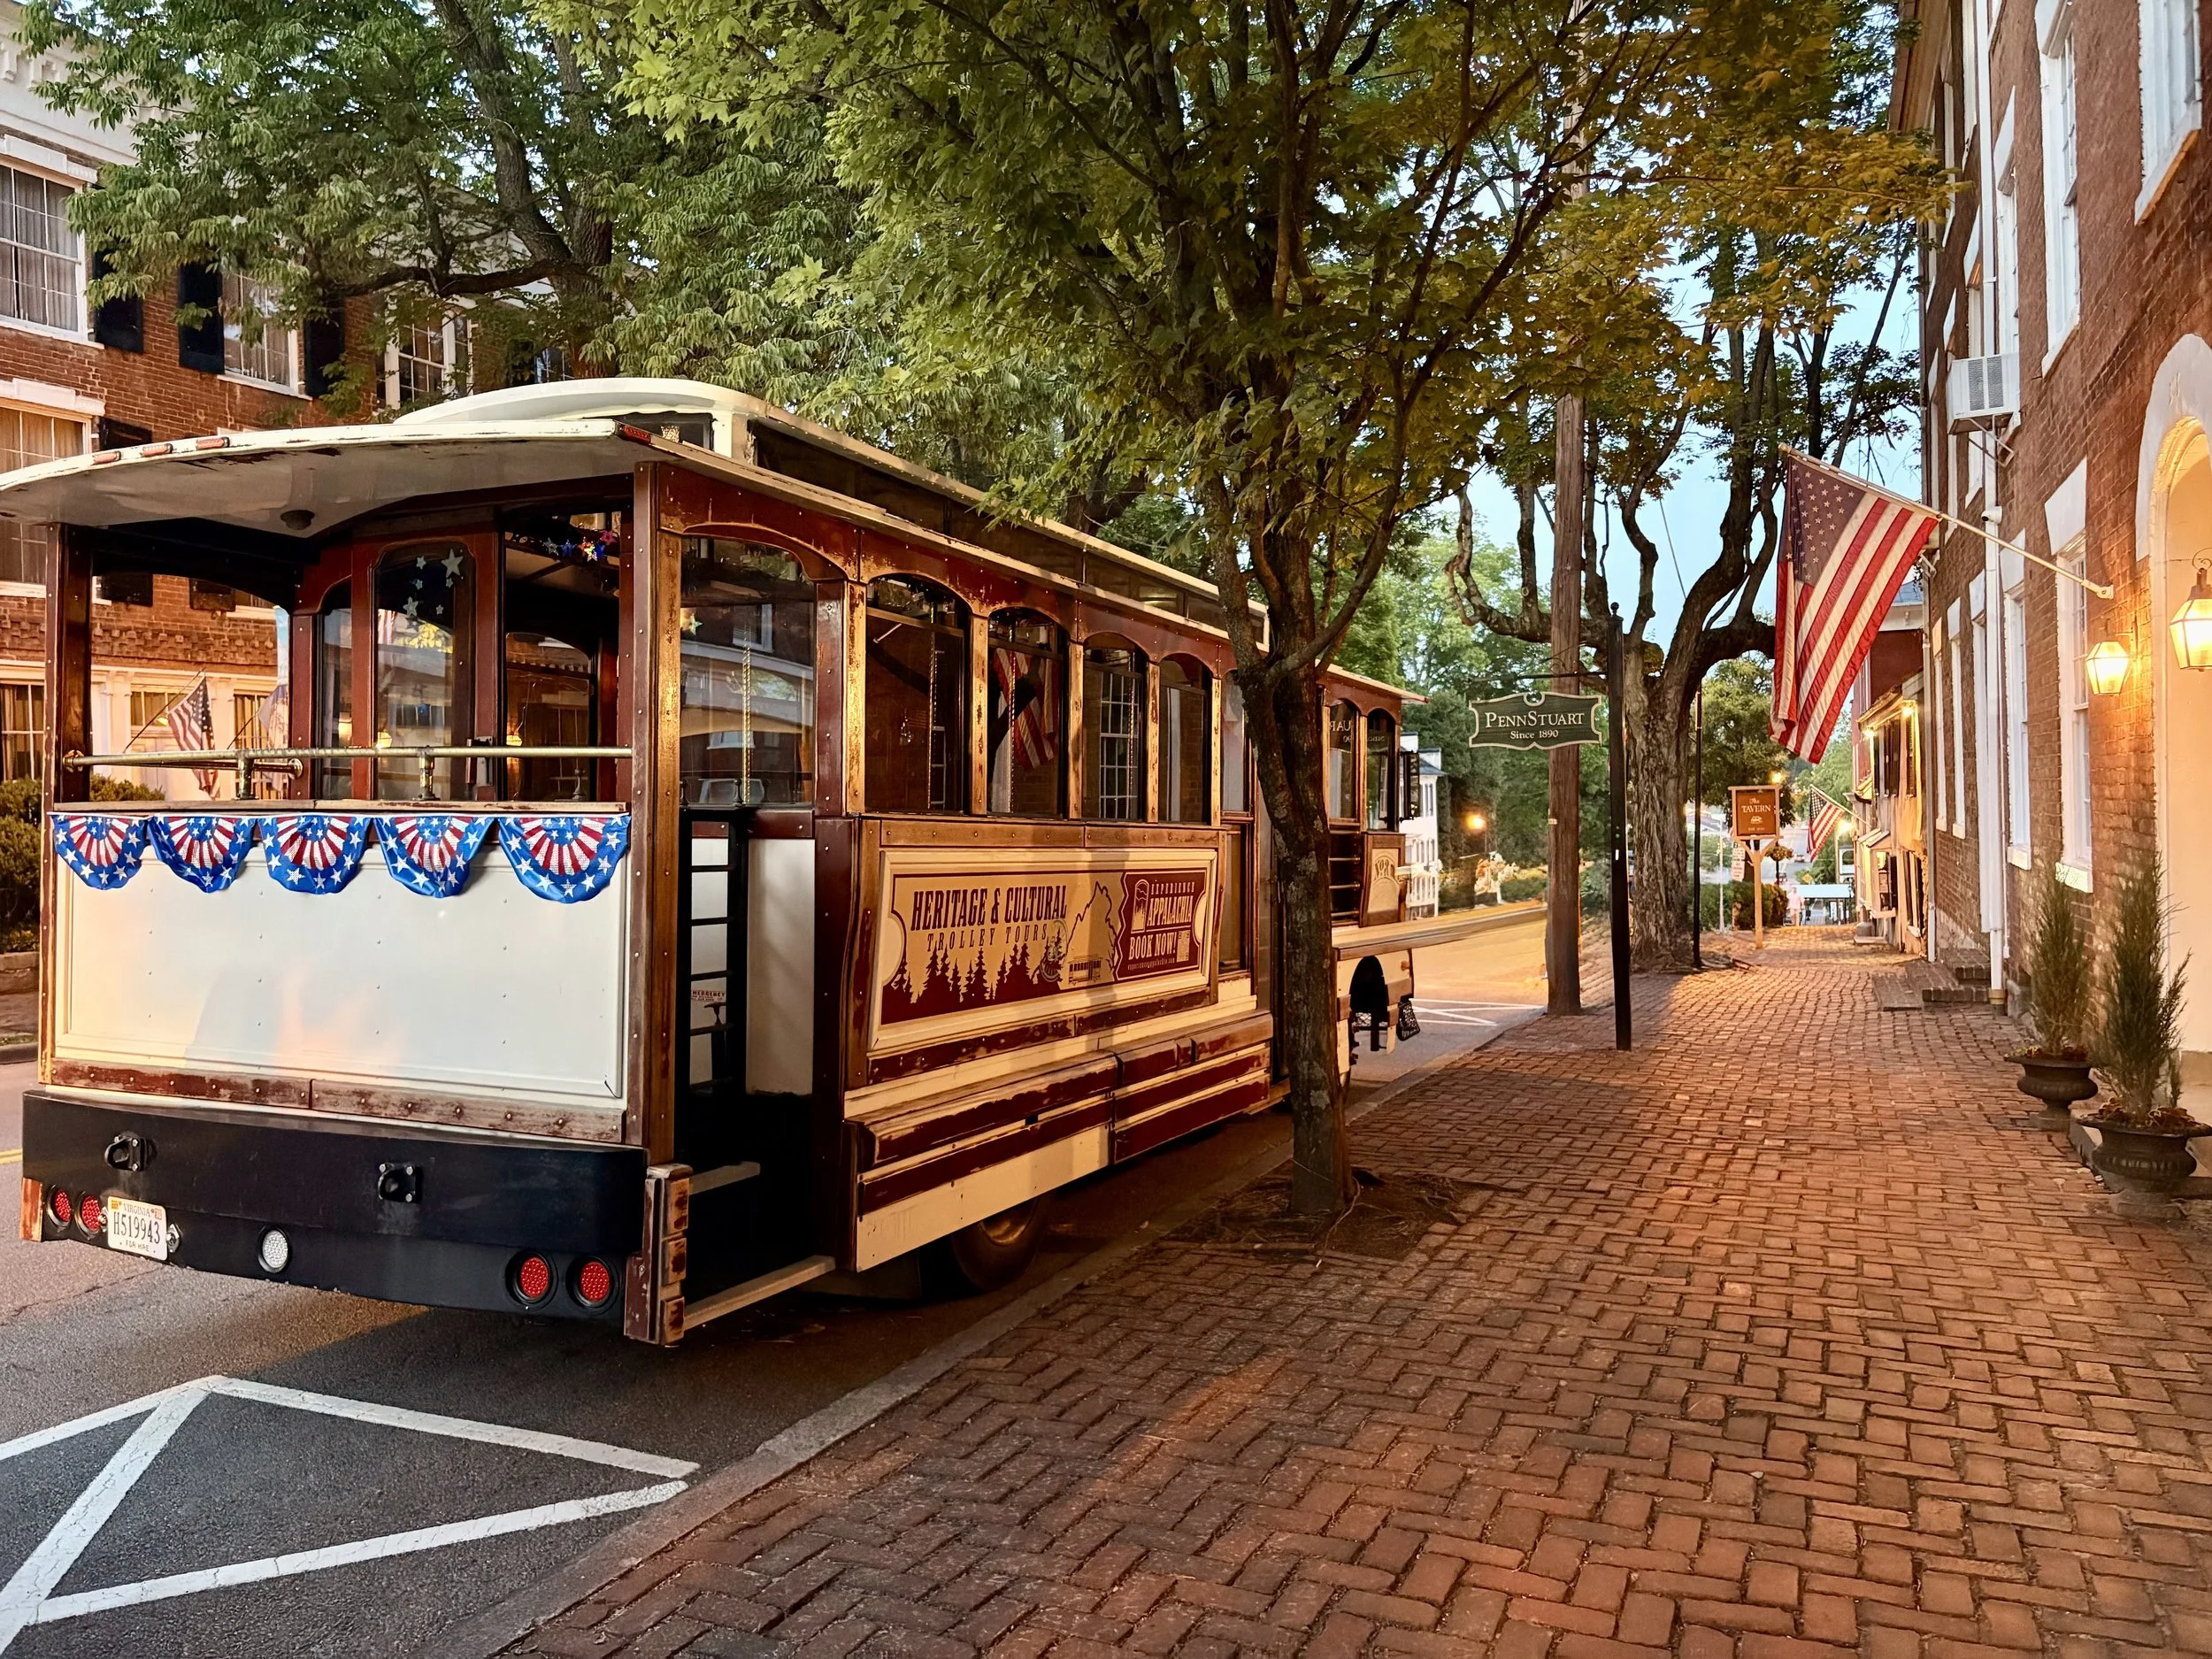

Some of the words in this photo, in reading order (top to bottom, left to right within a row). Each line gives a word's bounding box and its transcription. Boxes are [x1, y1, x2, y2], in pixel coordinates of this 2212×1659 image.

[1485, 710, 1585, 728] PENNSTUART
[1509, 730, 1535, 740] Since
[1539, 729, 1559, 739] 1890
[1151, 882, 1194, 895] EXPERIENCE
[910, 888, 987, 931] HERITAGE
[990, 887, 1001, 925] &
[1004, 886, 1067, 923] CULTURAL
[1147, 895, 1193, 926] APPALACHIA
[927, 928, 995, 952] TROLLEY
[1005, 924, 1048, 944] TOURS
[1128, 934, 1154, 960] BOOK
[1154, 932, 1178, 956] NOW!
[123, 1203, 150, 1217] VIRGINIA
[114, 1211, 160, 1244] H519943
